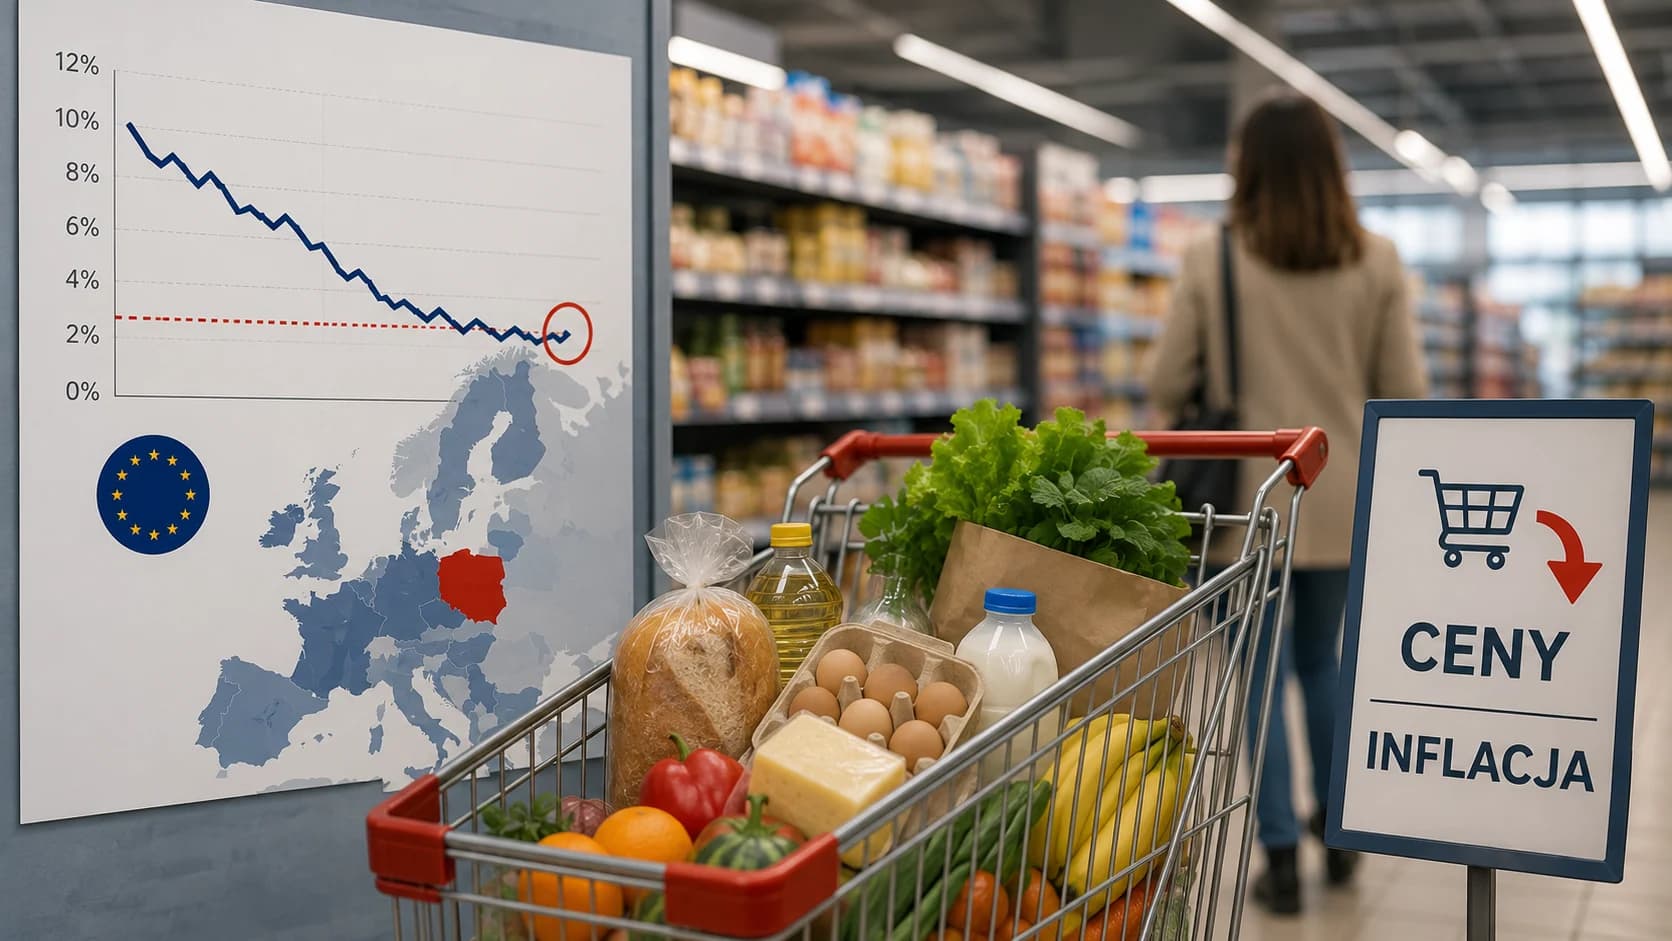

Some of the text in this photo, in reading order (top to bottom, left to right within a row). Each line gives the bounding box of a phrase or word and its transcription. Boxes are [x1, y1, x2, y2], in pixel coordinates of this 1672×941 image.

[56, 52, 99, 75] 12%
[56, 108, 99, 130] 10%
[66, 162, 99, 183] 8%
[67, 216, 99, 236] 6%
[66, 269, 99, 289] 4%
[67, 324, 99, 344] 2%
[66, 381, 99, 401] 0%
[1401, 622, 1570, 681] CENY
[1367, 731, 1594, 792] INFLACJA
